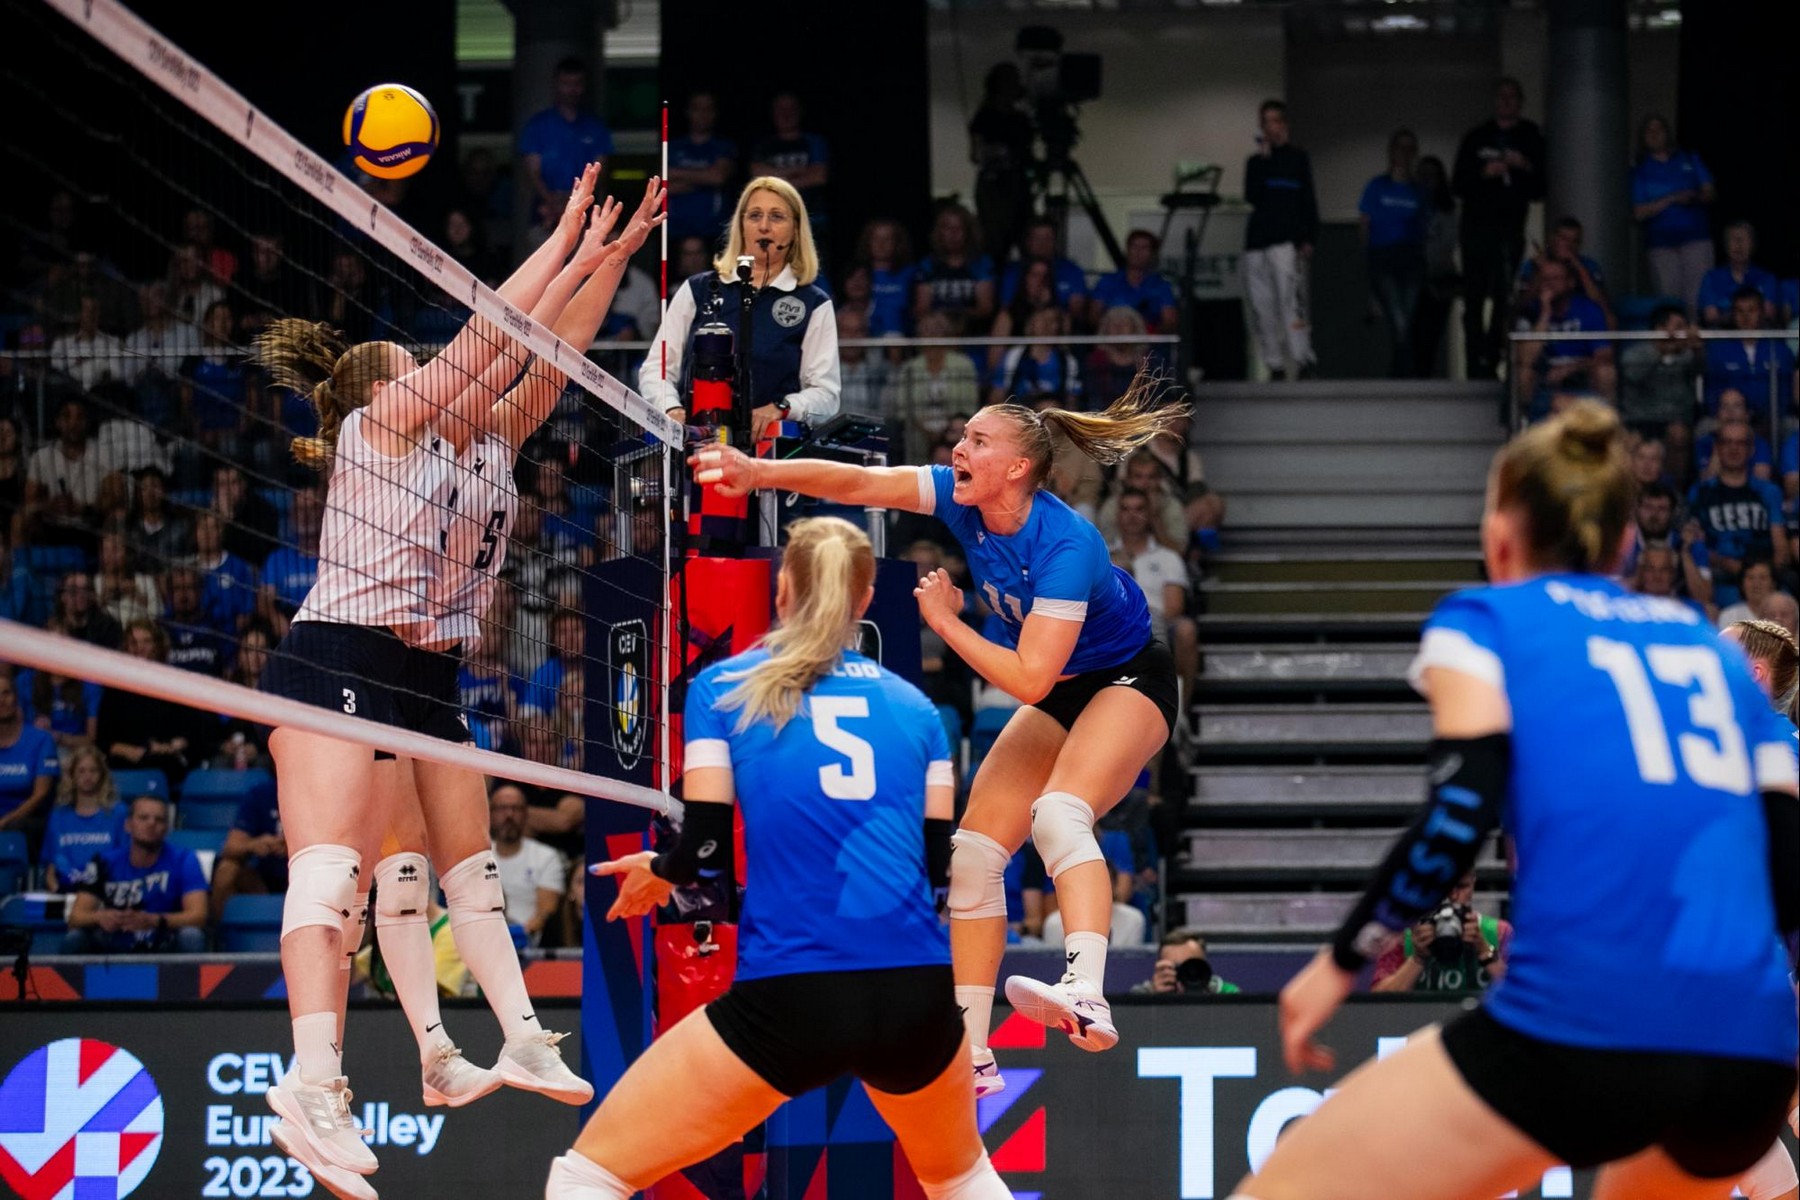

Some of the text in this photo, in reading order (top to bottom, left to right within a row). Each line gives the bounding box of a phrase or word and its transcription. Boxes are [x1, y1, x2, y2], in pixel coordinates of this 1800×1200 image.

[474, 510, 507, 570] 5
[342, 687, 356, 714] 3
[1585, 635, 1754, 797] 13
[808, 695, 877, 801] 5
[201, 1156, 315, 1199] 2023
